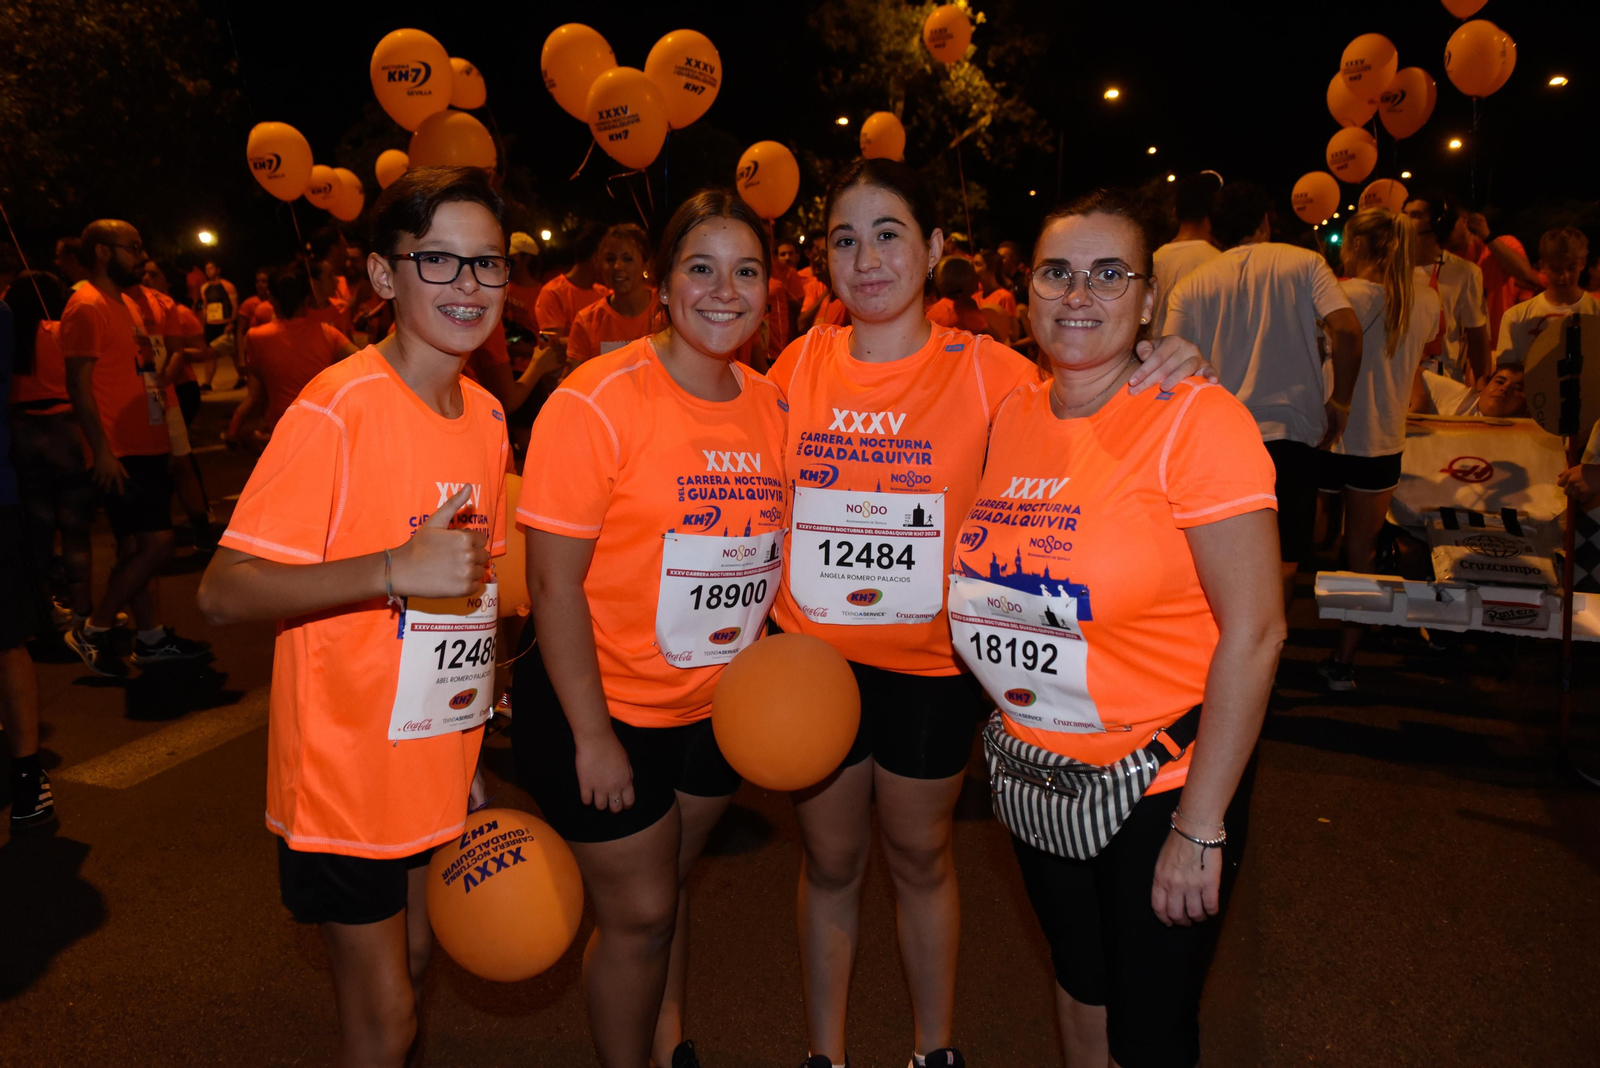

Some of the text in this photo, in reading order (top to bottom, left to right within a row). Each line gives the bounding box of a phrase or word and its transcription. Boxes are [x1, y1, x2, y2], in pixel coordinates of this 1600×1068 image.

[685, 57, 715, 75] XXXV
[597, 105, 628, 120] XXXV
[828, 408, 906, 435] XXXV
[801, 431, 932, 449] CARRERA NOCTURNA
[702, 450, 760, 473] XXXV
[803, 444, 932, 465] GUADALQUIVIR
[677, 475, 782, 488] CARRERA NOCTURNA
[1000, 476, 1070, 500] XXXV
[688, 488, 783, 502] GUADALQUIVIR
[975, 499, 1081, 515] CARRERA NOCTURNA
[971, 509, 1078, 531] GUADALQUIVIR
[818, 539, 915, 570] 12484
[820, 571, 845, 580] ÁNGELA
[877, 575, 911, 583] PALACIOS
[1460, 560, 1541, 576] Cruzcampo
[690, 578, 767, 610] 18900
[985, 619, 1010, 627] NOCTURNA
[970, 632, 1058, 675] 18192
[436, 676, 449, 684] ABEL
[450, 674, 473, 683] ROMERO
[441, 829, 525, 881] GUADALQUIVIR
[444, 835, 534, 887] CARRERA NOCTURNA
[462, 846, 528, 894] XXXV
